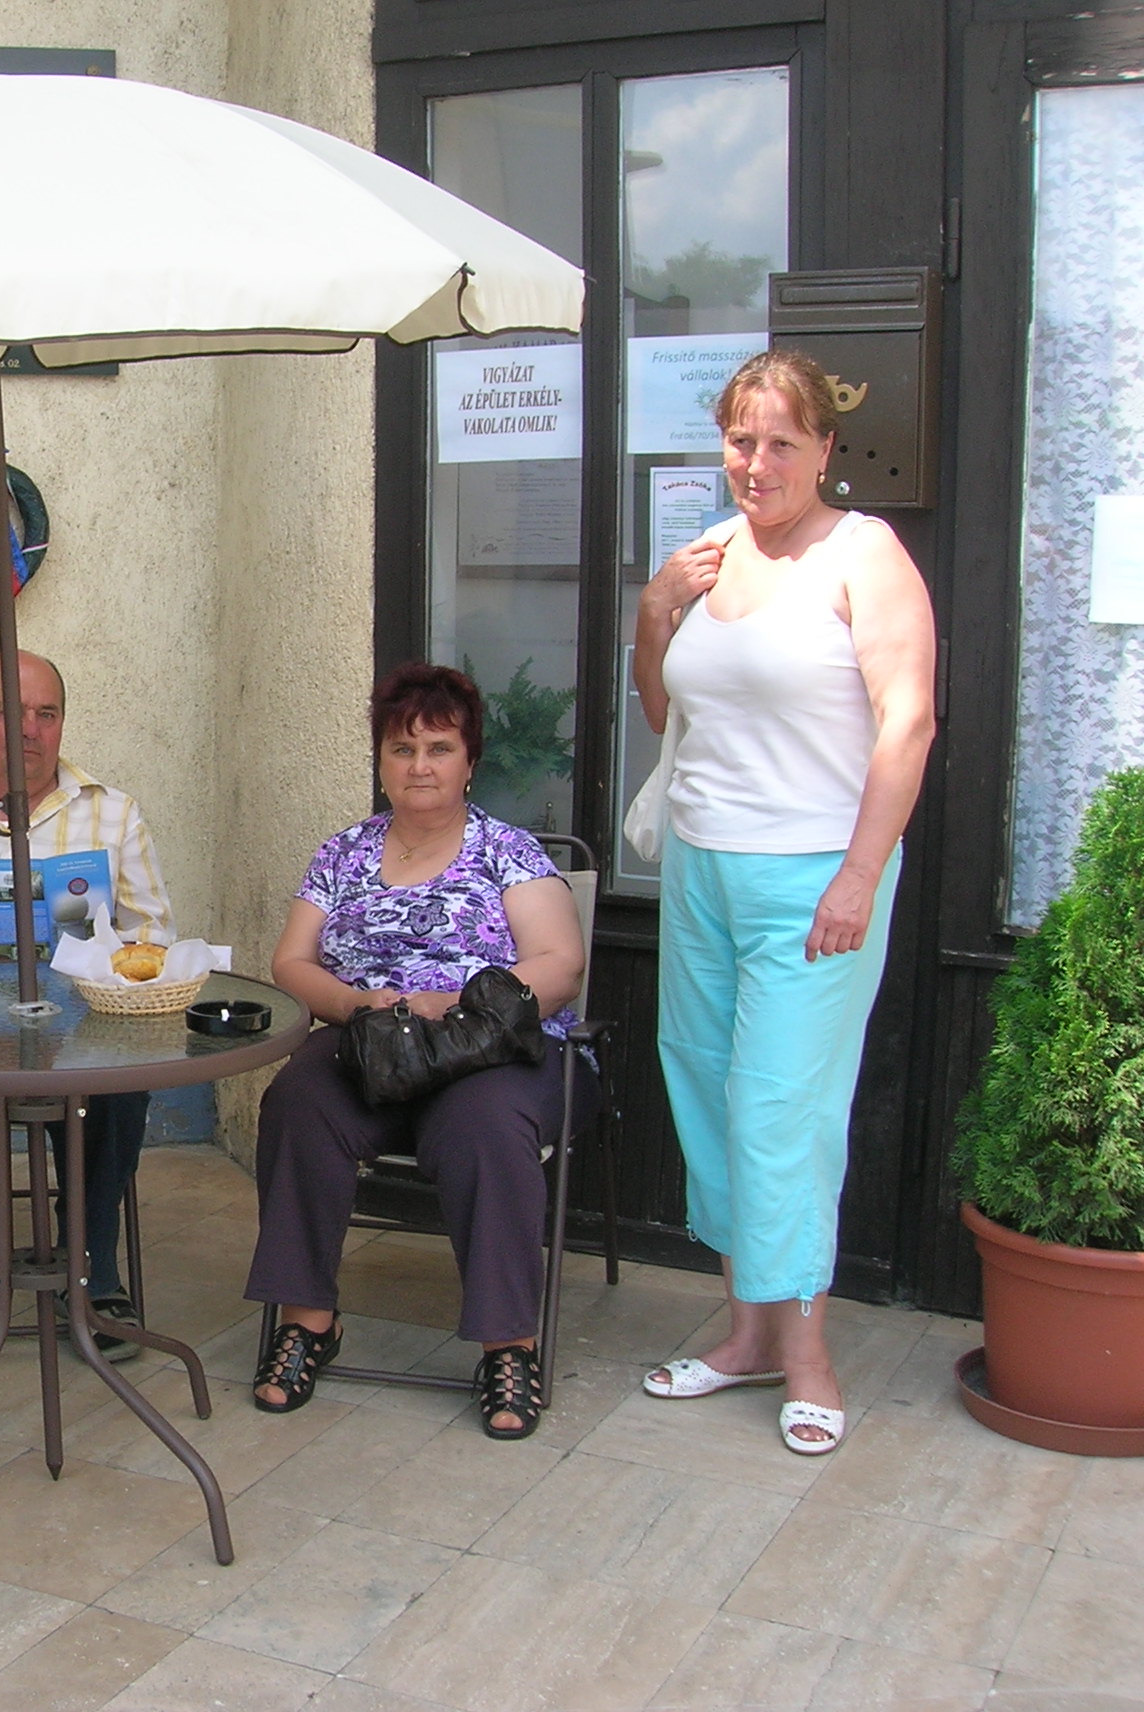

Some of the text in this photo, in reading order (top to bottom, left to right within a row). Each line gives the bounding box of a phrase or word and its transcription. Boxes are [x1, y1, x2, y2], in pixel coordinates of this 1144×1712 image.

[483, 362, 534, 384] VIGYÁZAT
[459, 393, 474, 411] AZ
[475, 388, 517, 410] ÉPÜLET
[463, 414, 557, 436] VAKOLATA OMLIK!
